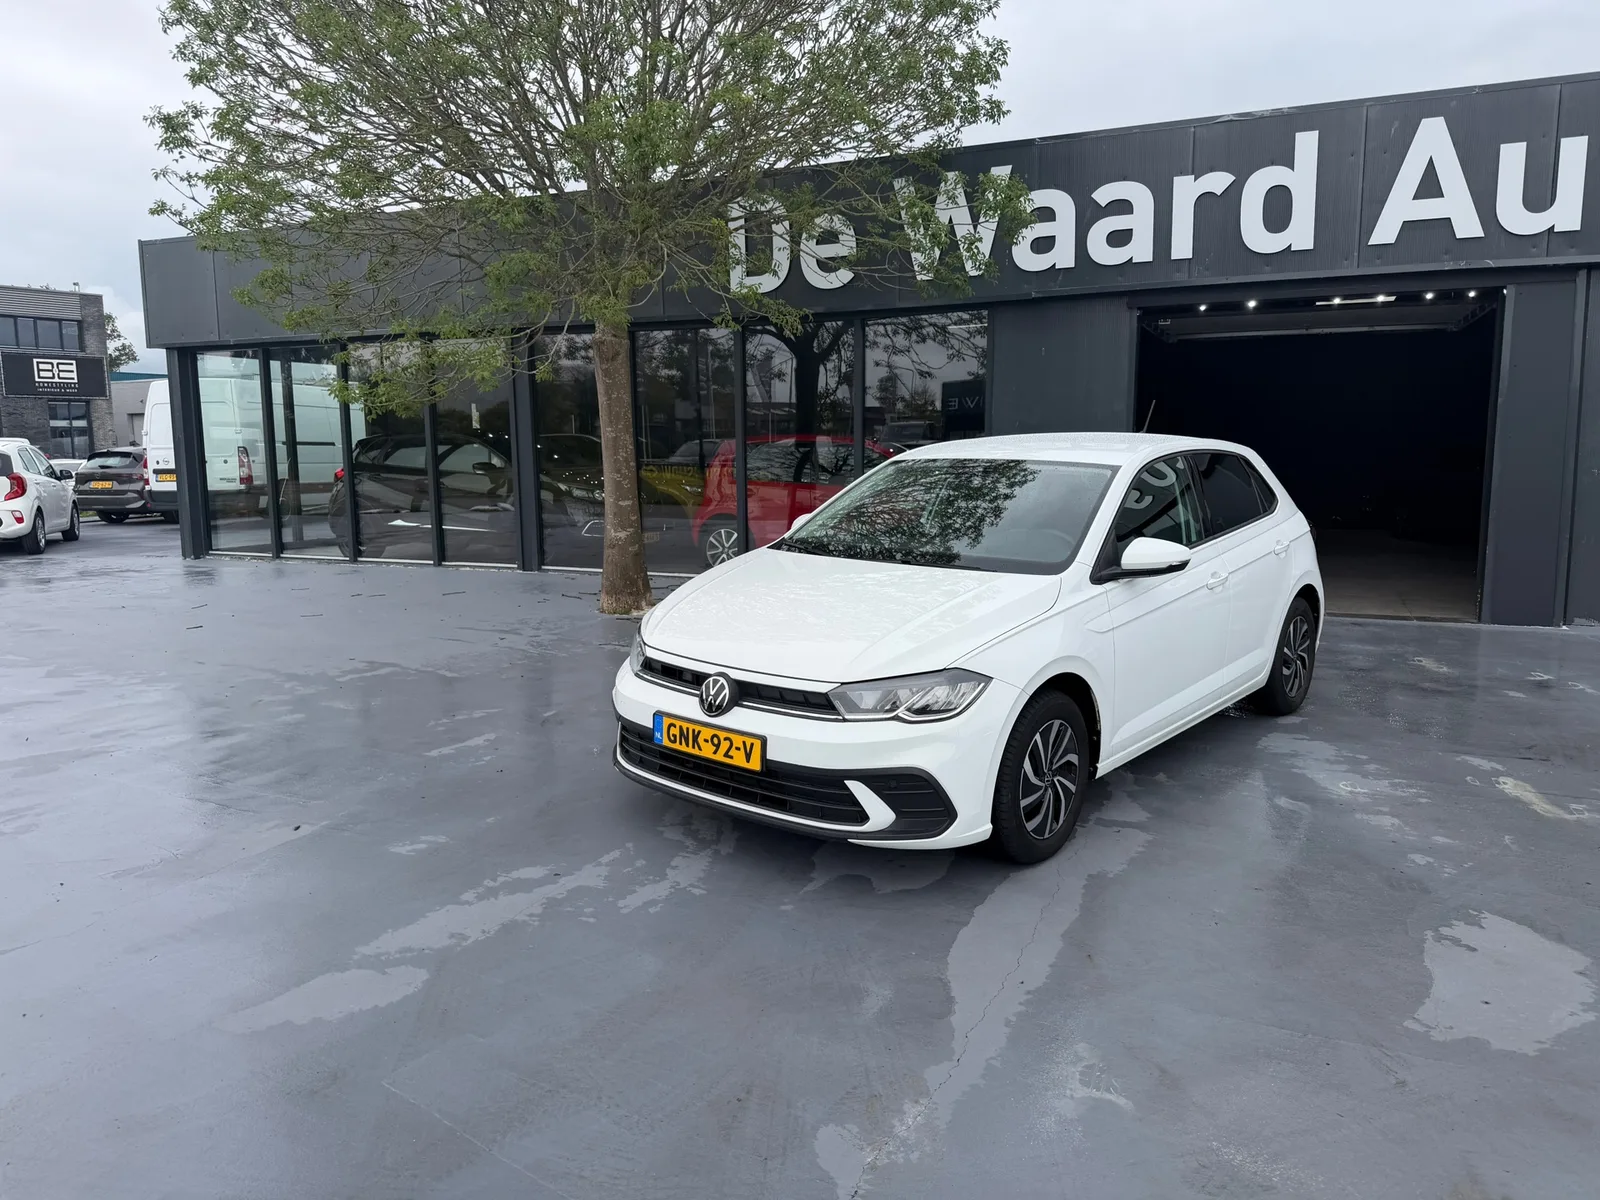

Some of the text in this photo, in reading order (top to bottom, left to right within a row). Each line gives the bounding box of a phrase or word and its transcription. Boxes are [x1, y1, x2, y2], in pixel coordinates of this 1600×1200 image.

[727, 116, 1589, 294] De Waard Au
[666, 722, 755, 764] GNK-92-V
